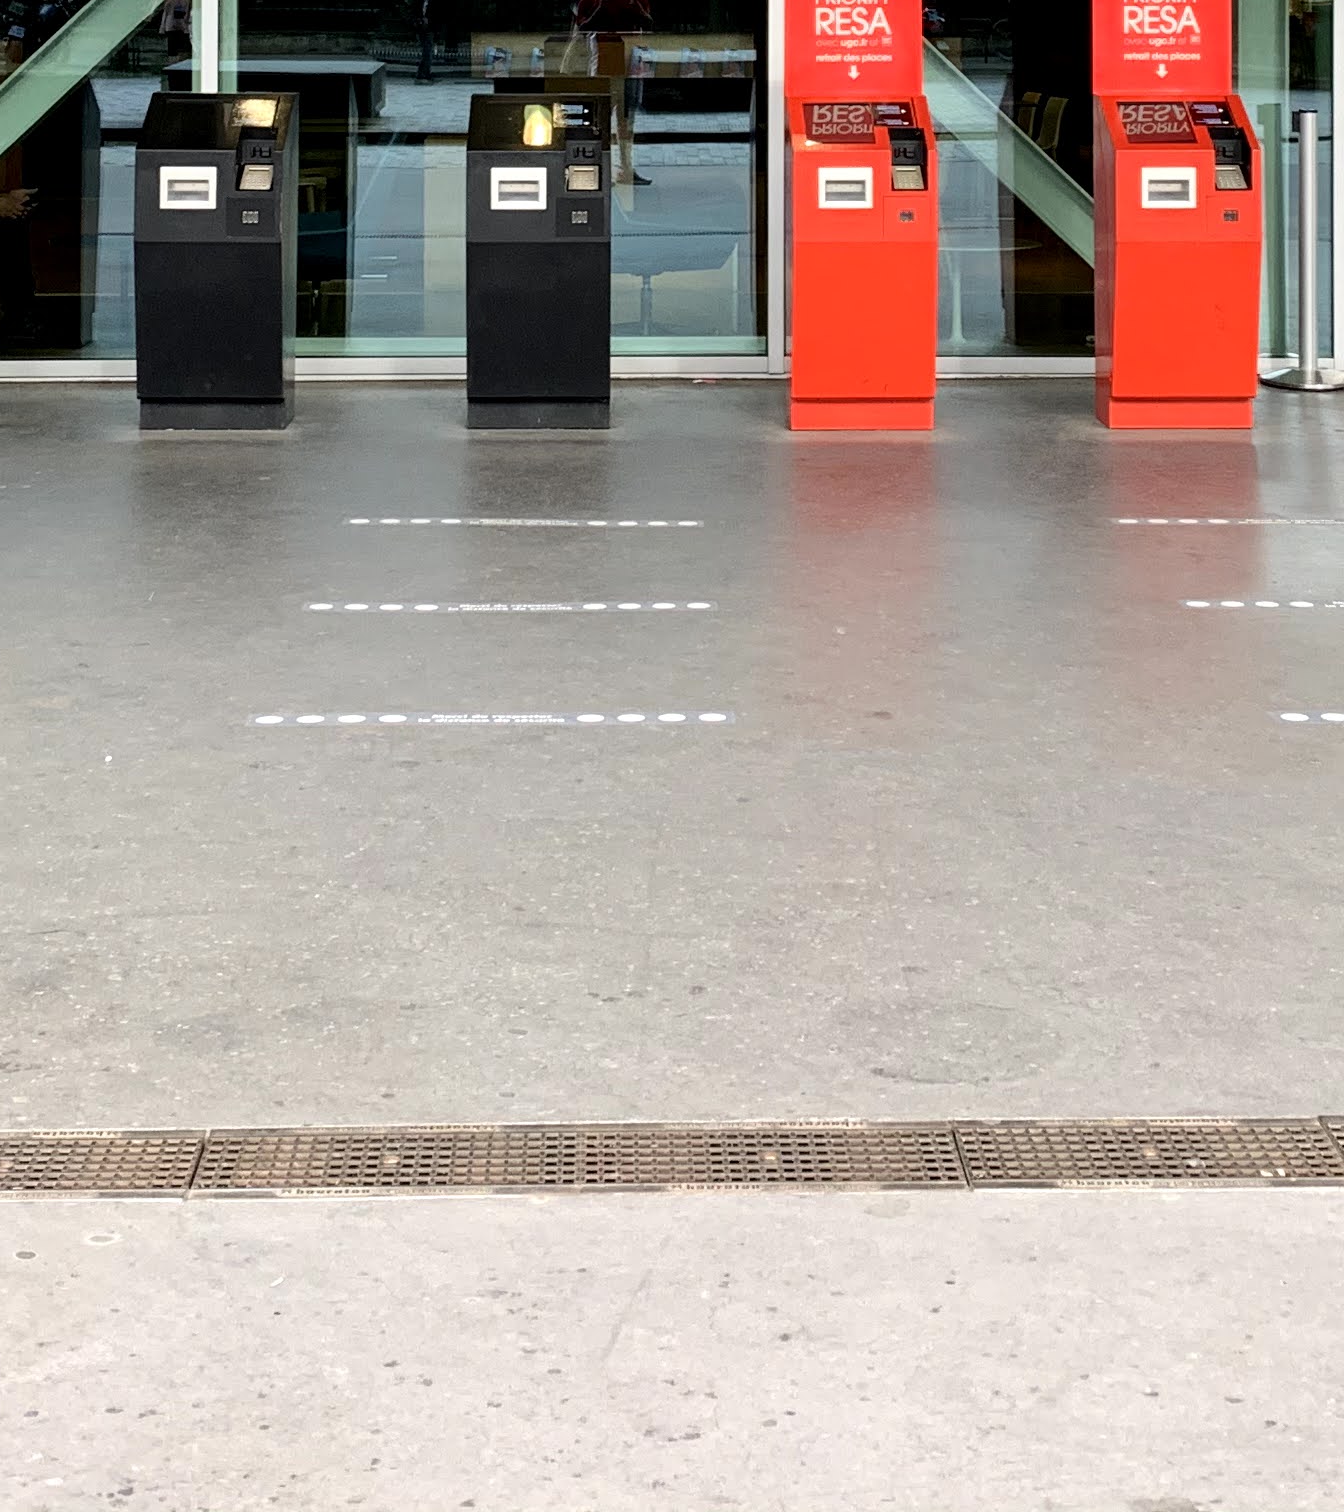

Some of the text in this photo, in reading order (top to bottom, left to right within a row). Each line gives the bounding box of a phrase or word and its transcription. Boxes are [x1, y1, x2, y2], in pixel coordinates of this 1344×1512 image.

[815, 6, 892, 36] RESA
[1123, 5, 1201, 35] RESA
[843, 53, 860, 62] des
[1151, 52, 1169, 61] des
